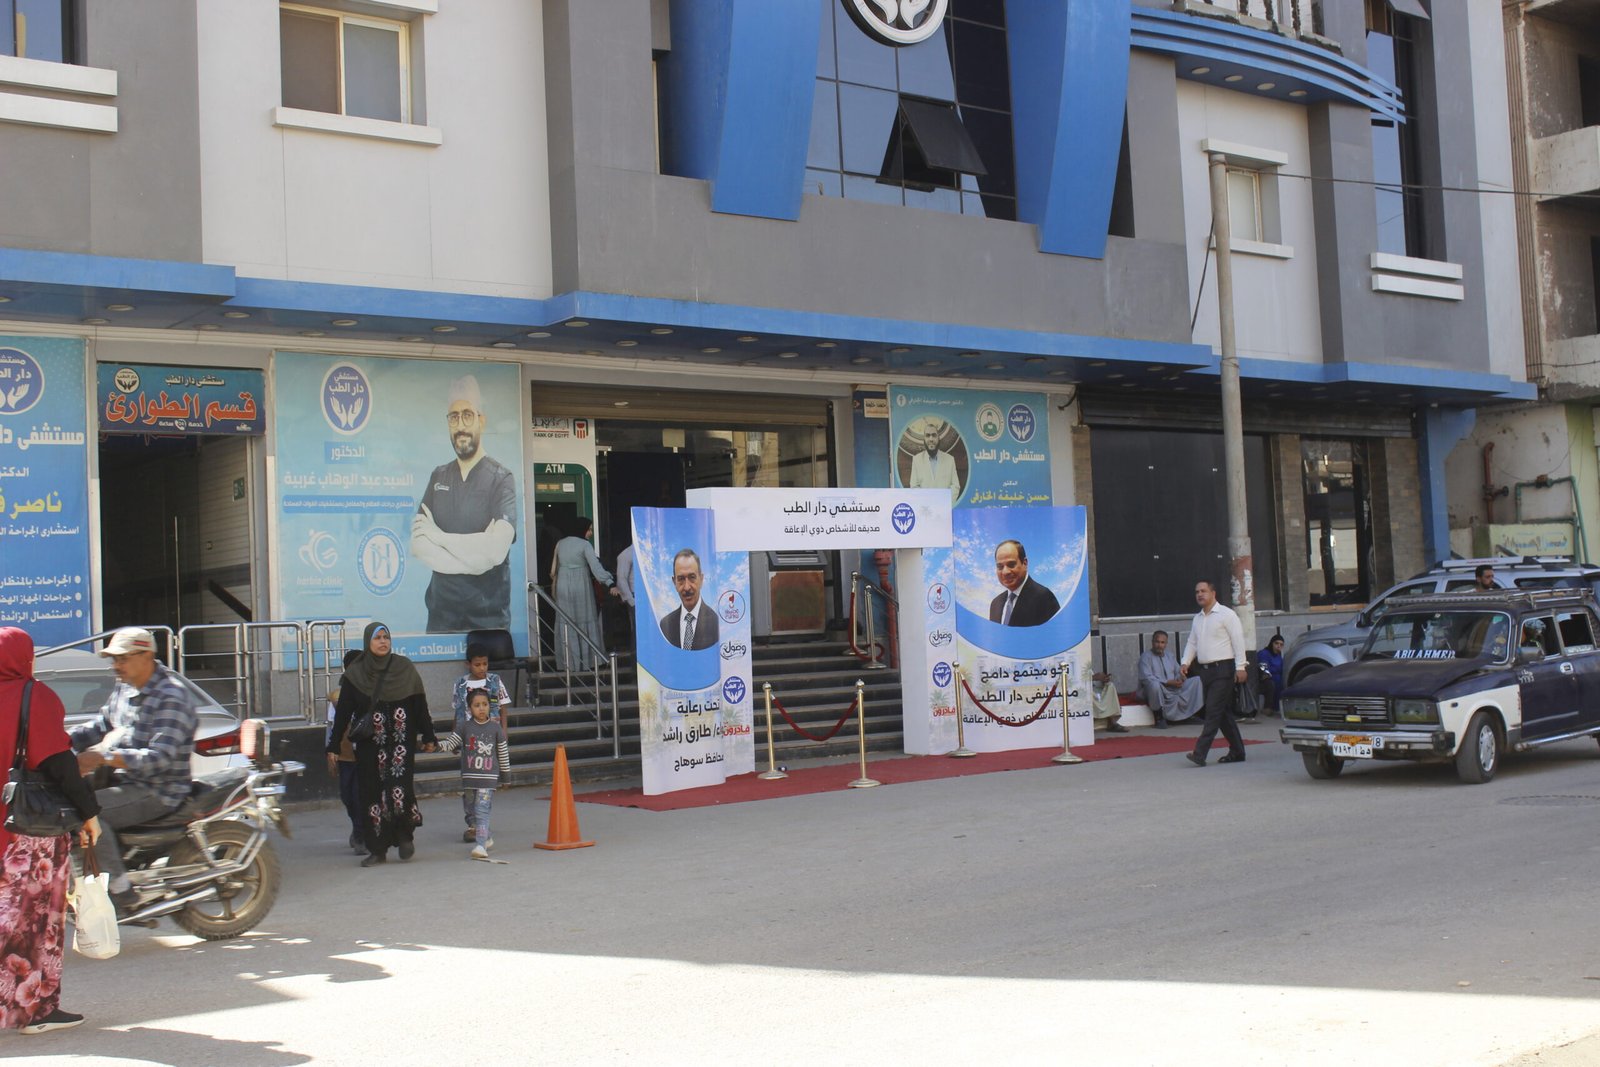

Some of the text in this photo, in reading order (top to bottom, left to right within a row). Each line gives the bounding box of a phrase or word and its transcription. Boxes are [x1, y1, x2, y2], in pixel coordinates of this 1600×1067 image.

[0, 354, 26, 365] مستش
[15, 368, 32, 382] دار
[165, 375, 184, 387] الطب
[185, 375, 195, 387] دار
[329, 382, 365, 395] دار الطب
[105, 389, 257, 428] قسم الطوارئ
[0, 422, 84, 450] مستشفى دا
[331, 445, 365, 460] الدكتور
[974, 449, 997, 463] الطب
[999, 449, 1010, 464] دار
[0, 466, 30, 478] الدكت
[545, 464, 566, 473] ATM
[318, 472, 358, 489] الوهاب
[361, 474, 381, 489] عبد
[383, 472, 414, 489] السيد
[9, 490, 62, 520] ناصر
[783, 501, 811, 516] الطب
[814, 501, 827, 516] دار
[8, 525, 39, 538] الجراحة
[784, 524, 808, 536] الإعاقة
[826, 523, 857, 534] للأشخاص
[0, 574, 72, 589] الجراحات بالمنظار
[0, 593, 72, 605] جراحات الجهاز الهض
[1394, 650, 1415, 659] ABU
[981, 667, 1009, 683] دامج
[1013, 666, 1048, 682] مجتمع
[1009, 690, 1023, 704] دار
[1026, 687, 1078, 704] مشفى
[677, 699, 702, 717] رعاية
[1019, 709, 1057, 722] للأشاص
[963, 714, 993, 726] الإعاقة
[662, 726, 683, 744] راشد
[686, 723, 711, 743] طارق
[1375, 737, 1381, 747] 8
[467, 755, 493, 770] YOU
[674, 756, 703, 772] سوهاج
